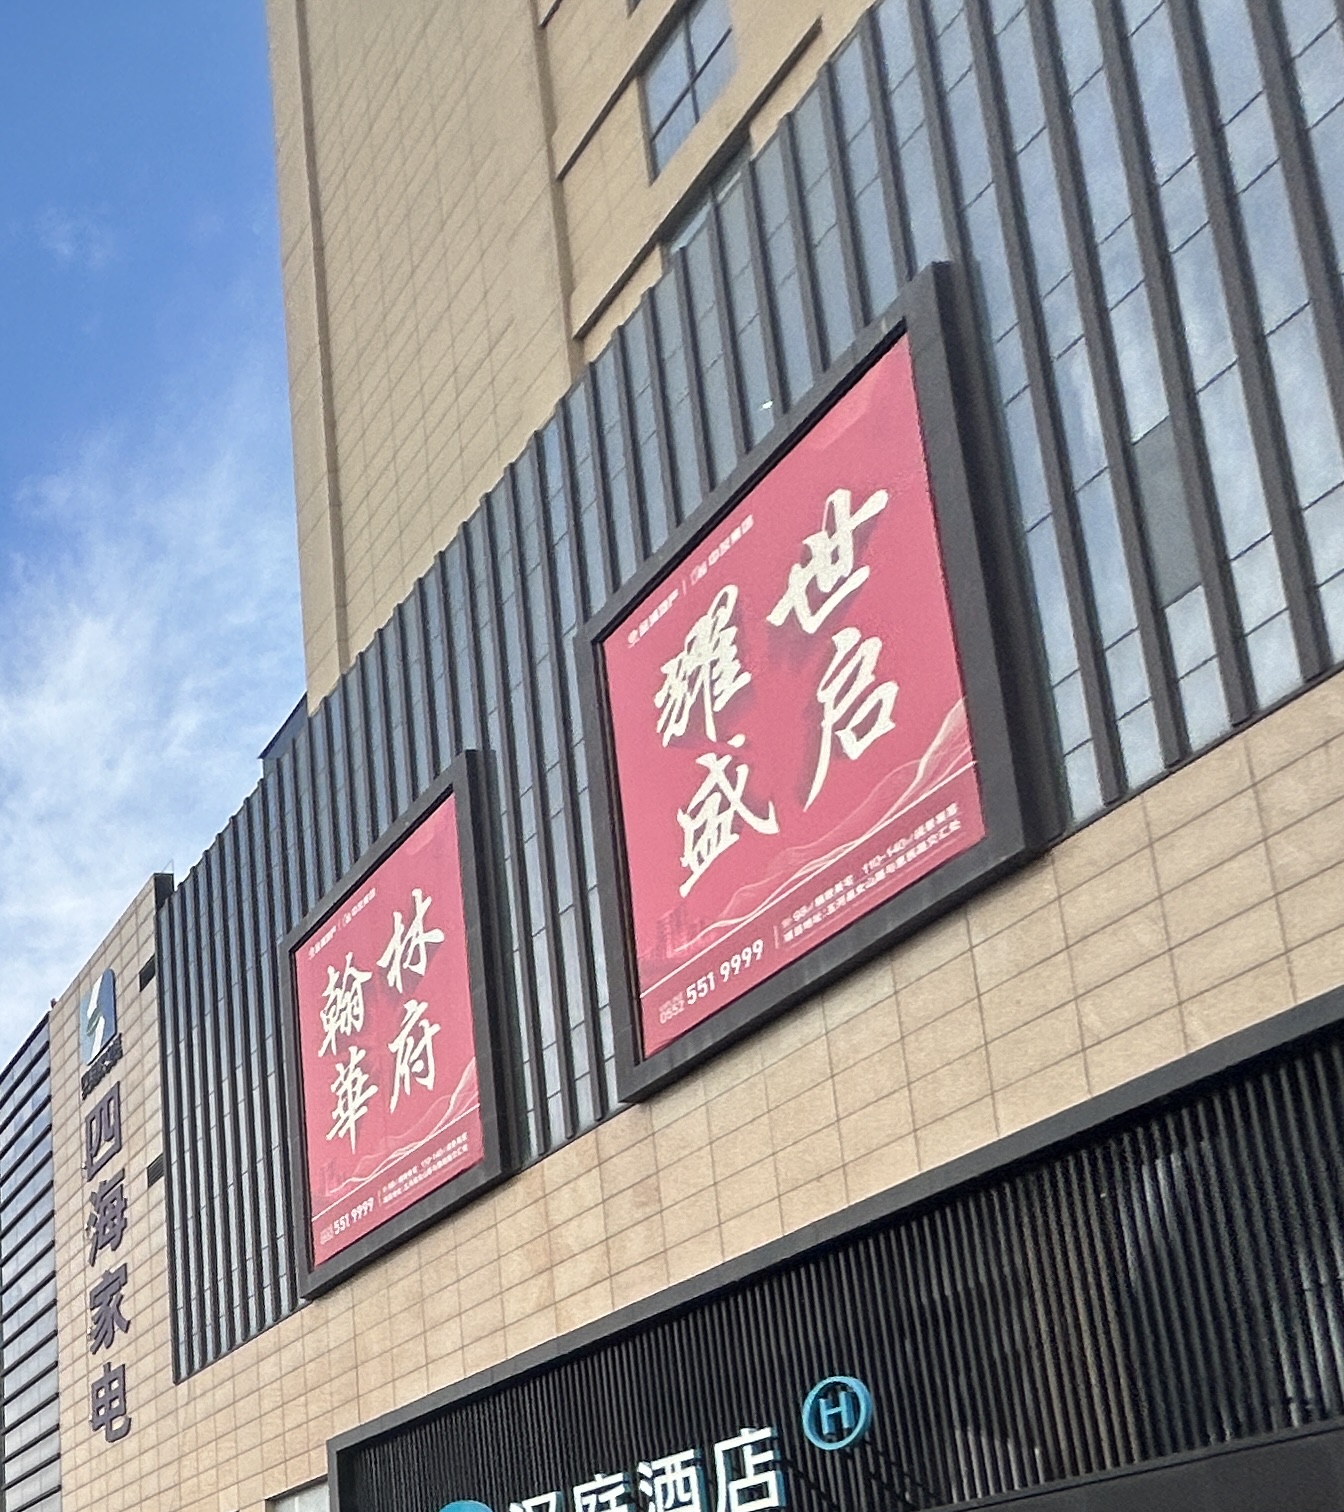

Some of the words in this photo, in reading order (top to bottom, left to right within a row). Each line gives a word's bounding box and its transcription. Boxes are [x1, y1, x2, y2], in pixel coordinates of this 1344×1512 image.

[685, 973, 716, 1004] 551
[719, 939, 764, 982] 9999
[84, 1082, 132, 1443] 四海家电
